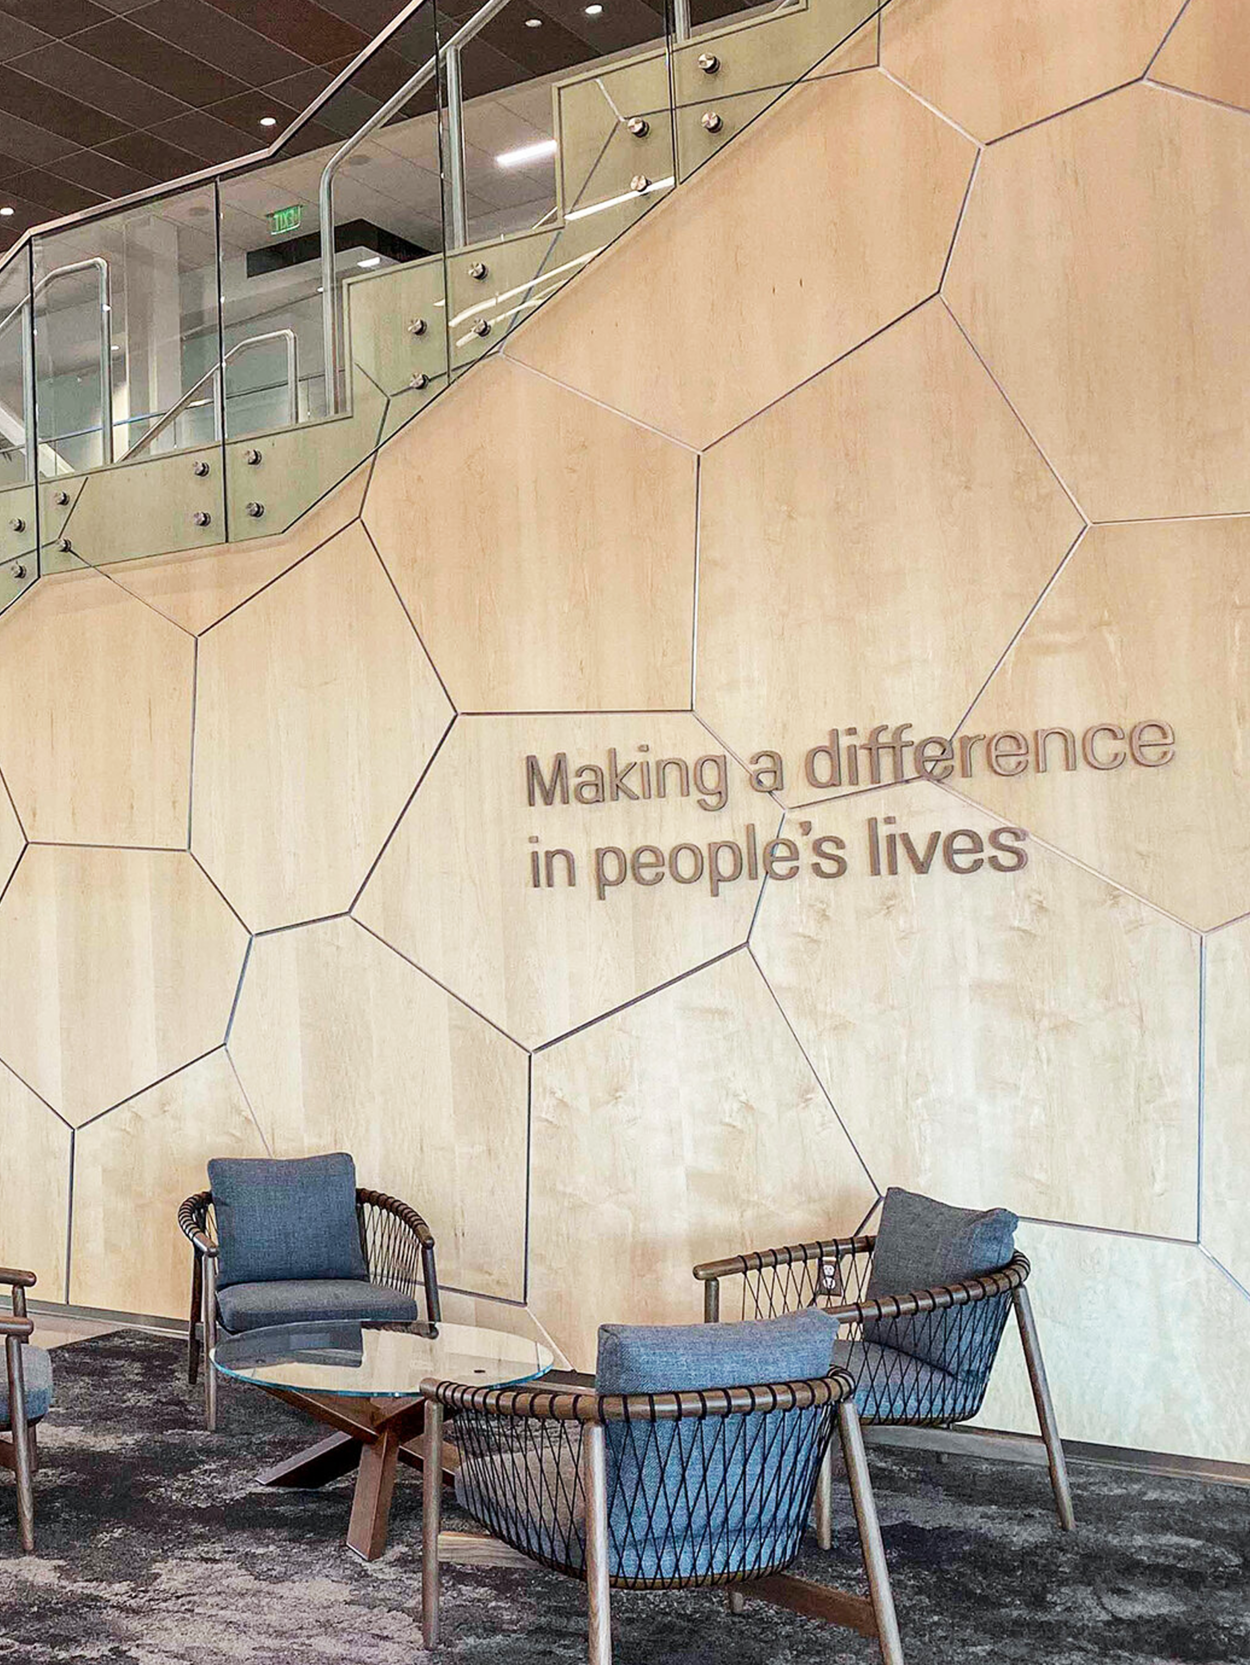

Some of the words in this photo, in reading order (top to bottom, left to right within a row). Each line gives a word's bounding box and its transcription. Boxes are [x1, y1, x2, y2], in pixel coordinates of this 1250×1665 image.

[525, 744, 730, 813] Making
[748, 750, 785, 794] a
[804, 719, 1177, 790] difference
[528, 835, 577, 888] in
[867, 815, 1031, 877] lives
